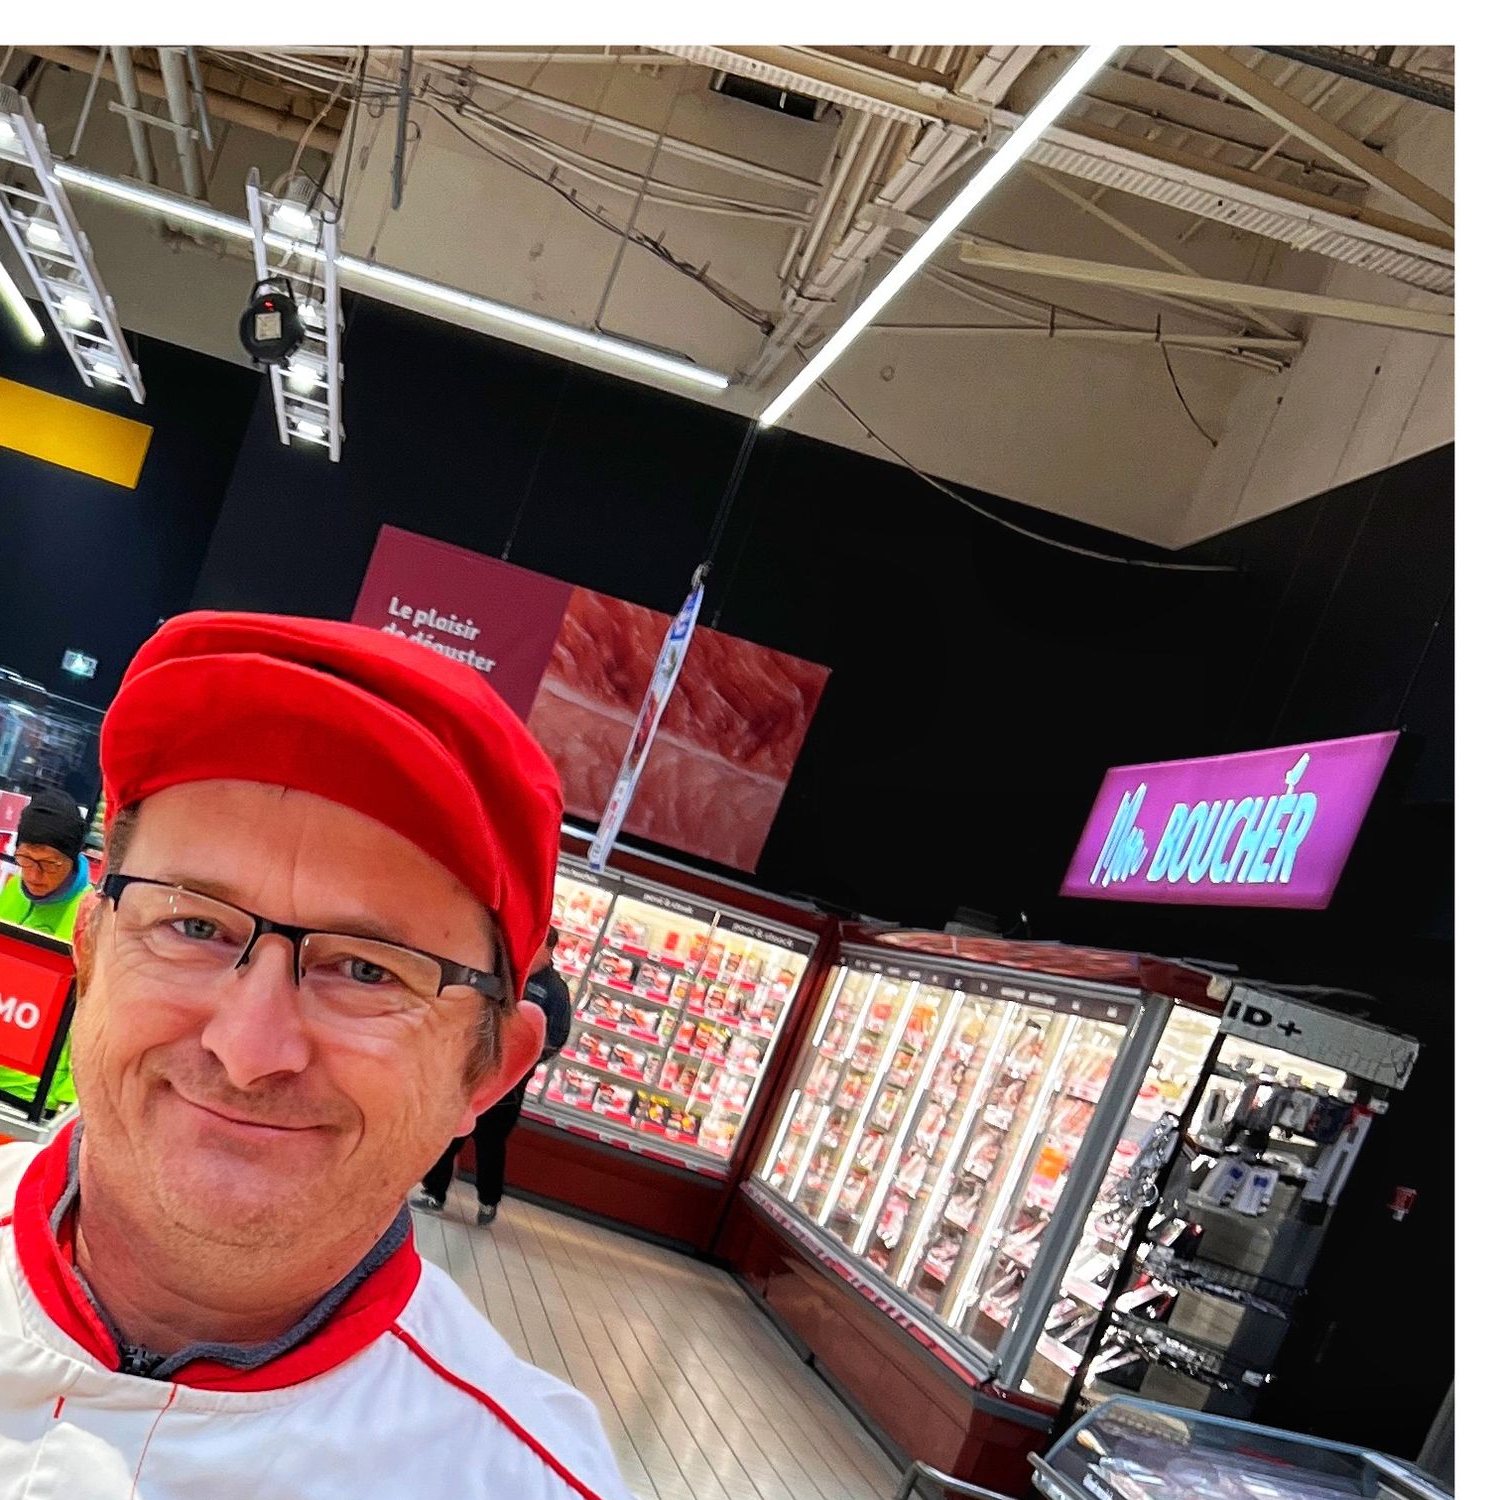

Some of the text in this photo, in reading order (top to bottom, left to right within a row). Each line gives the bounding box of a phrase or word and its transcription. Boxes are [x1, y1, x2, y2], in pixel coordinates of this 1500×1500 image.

[388, 596, 480, 641] Le plaisir
[1146, 790, 1318, 884] BOUCHER
